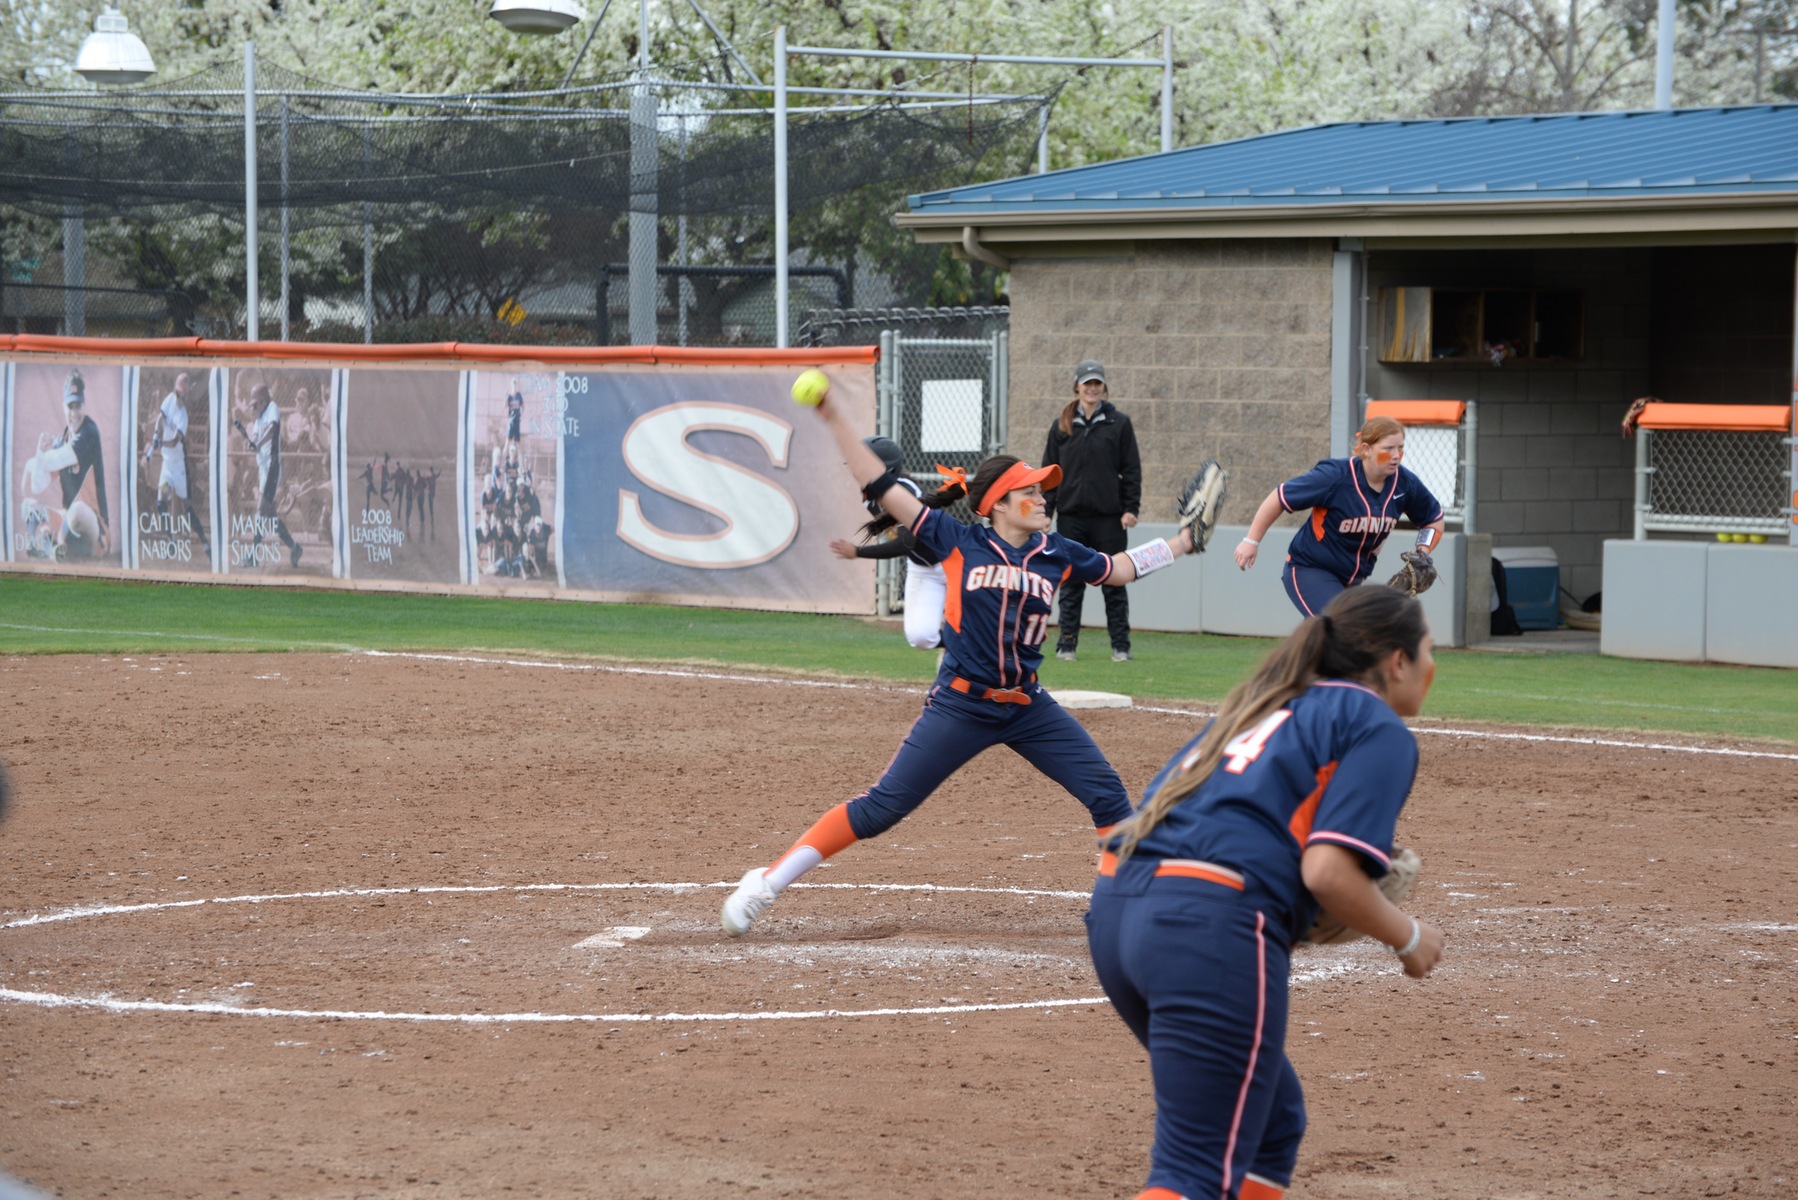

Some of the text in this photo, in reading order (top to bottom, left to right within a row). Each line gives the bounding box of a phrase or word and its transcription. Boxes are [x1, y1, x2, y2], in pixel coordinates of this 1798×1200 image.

[556, 376, 588, 394] 2008
[543, 415, 580, 440] STATE
[616, 401, 799, 569] S
[139, 512, 191, 534] CAITLIN
[231, 512, 279, 537] MARKIE
[362, 509, 392, 525] 2008
[1339, 516, 1397, 533] GIANTS
[351, 524, 405, 548] LEADERSHIP
[141, 539, 192, 562] NABORS
[231, 540, 281, 567] SIMONS
[363, 543, 392, 565] TEAM
[966, 564, 1053, 606] GIANTS
[1023, 613, 1050, 646] 11
[1181, 709, 1293, 774] 4
